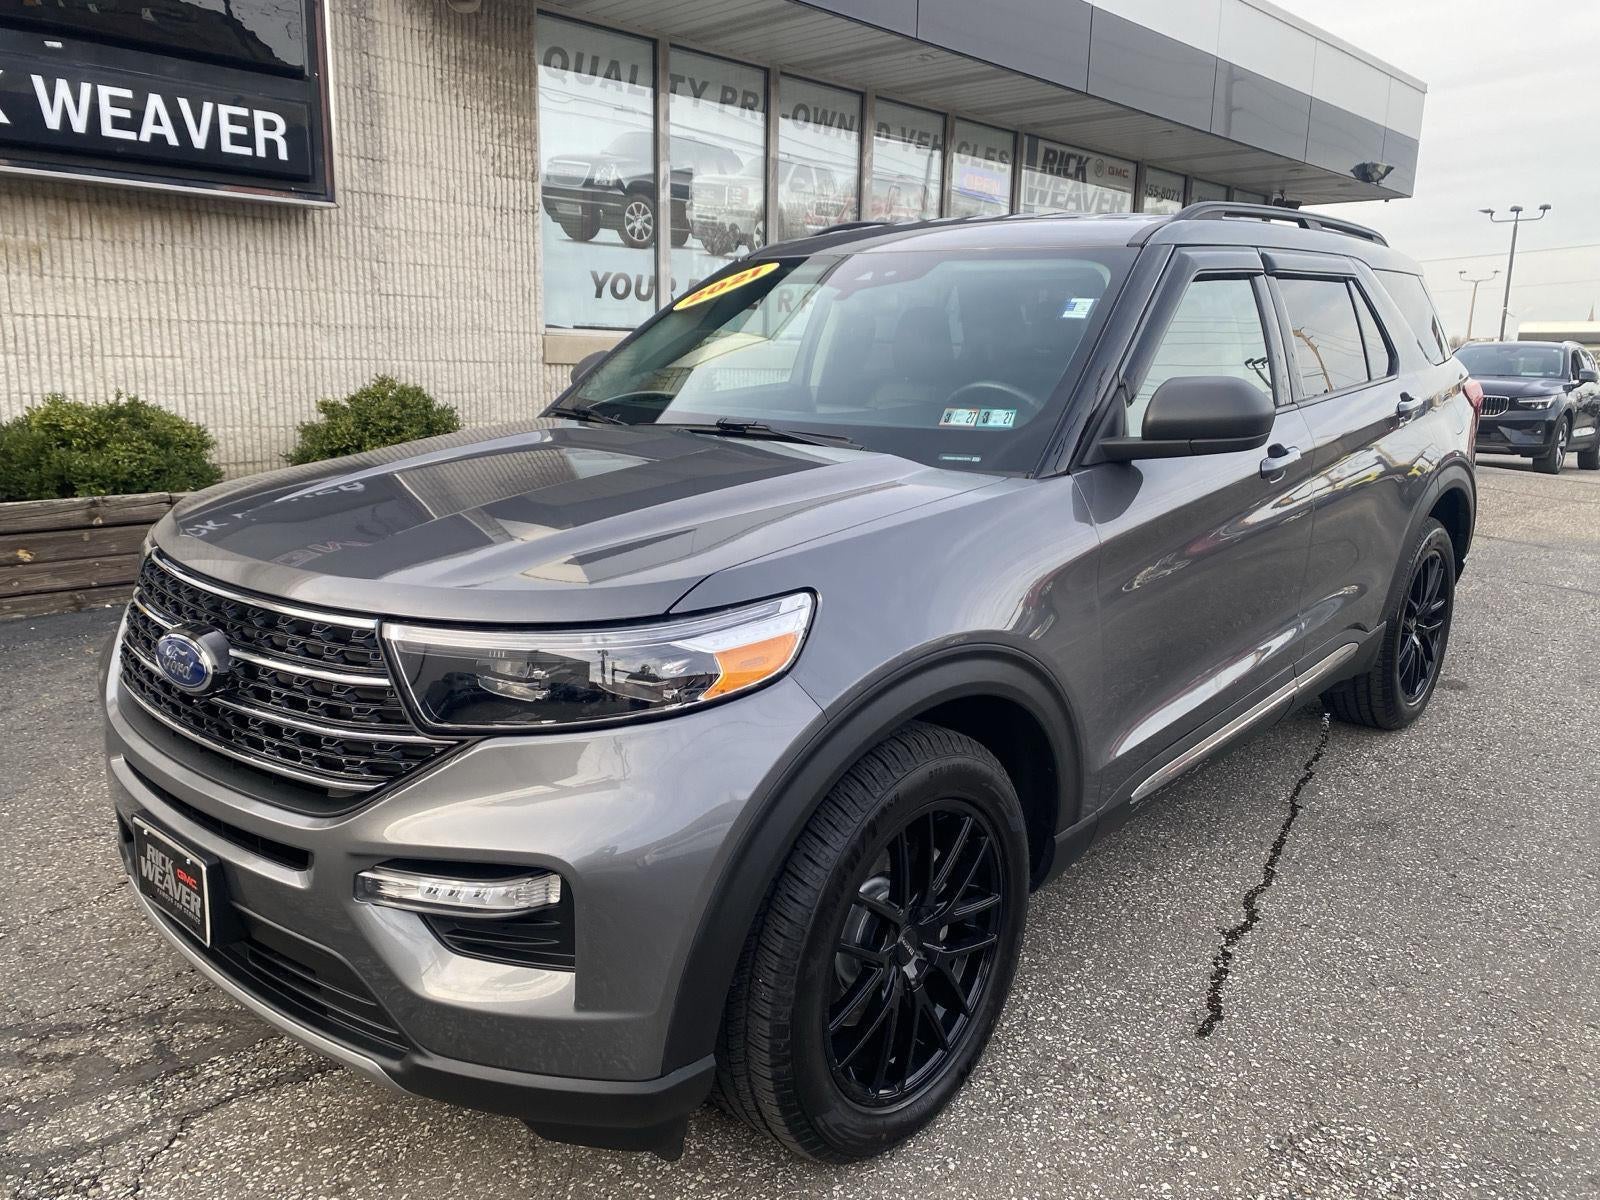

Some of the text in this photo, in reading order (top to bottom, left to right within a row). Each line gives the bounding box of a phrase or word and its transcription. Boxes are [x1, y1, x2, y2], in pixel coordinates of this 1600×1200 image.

[543, 46, 712, 109] QUALTY
[30, 73, 289, 161] WEAVER
[966, 173, 1002, 192] OPEN
[1041, 146, 1090, 184] RICK
[1107, 165, 1130, 180] GMC
[1025, 172, 1129, 215] WEAVER
[687, 264, 762, 304] 2021
[944, 411, 977, 424] 3 27
[982, 411, 1014, 425] 3 27
[162, 644, 195, 681] Ford
[146, 842, 174, 875] RICK
[140, 855, 201, 919] WEAVER
[176, 867, 198, 890] GMC
